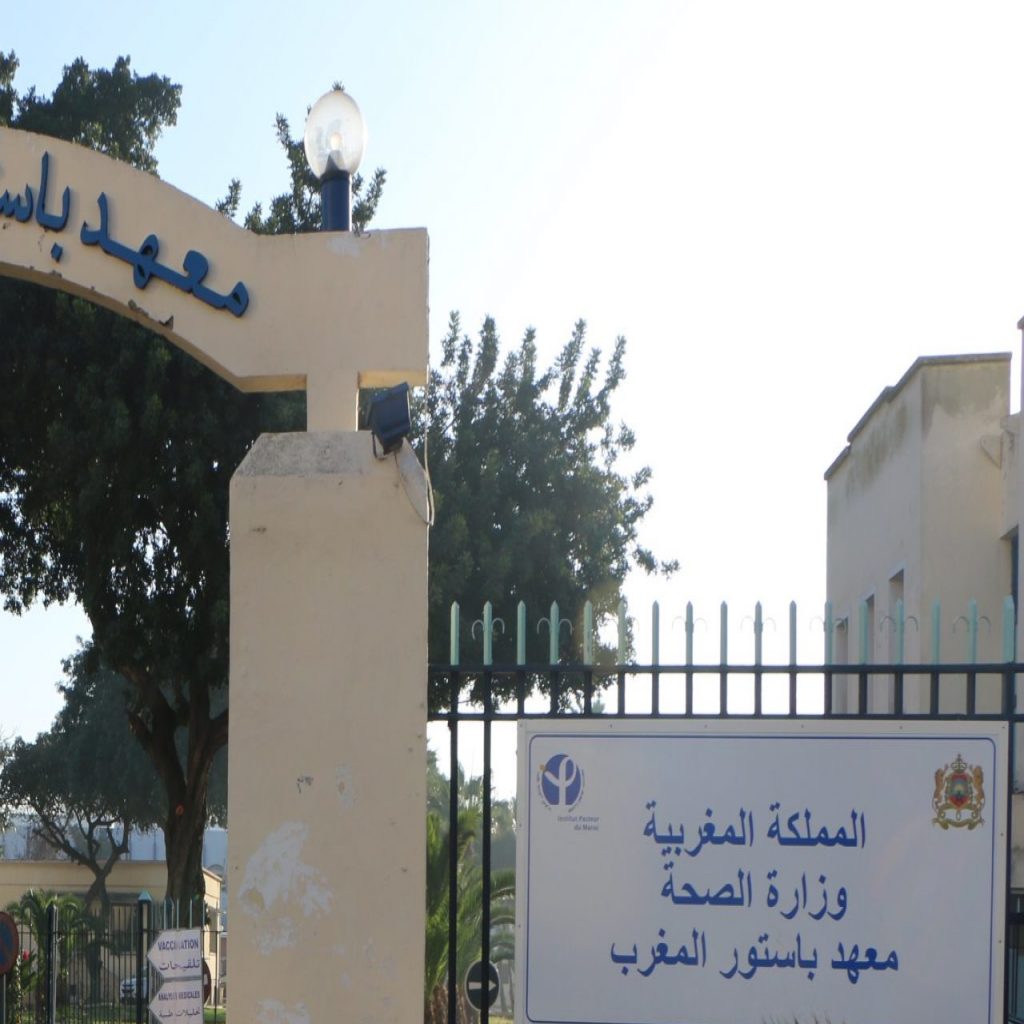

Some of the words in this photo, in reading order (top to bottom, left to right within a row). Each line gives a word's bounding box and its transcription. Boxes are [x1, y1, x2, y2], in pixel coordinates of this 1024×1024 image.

[80, 191, 250, 318] معهد
[642, 800, 754, 857] المغربية
[766, 802, 866, 849] المملكة
[661, 861, 753, 907] الصحة
[766, 870, 848, 921] وزارة
[158, 939, 199, 951] VACCIATION
[610, 928, 707, 978] المغرب
[719, 933, 819, 981] باستور
[831, 941, 899, 985] معهد
